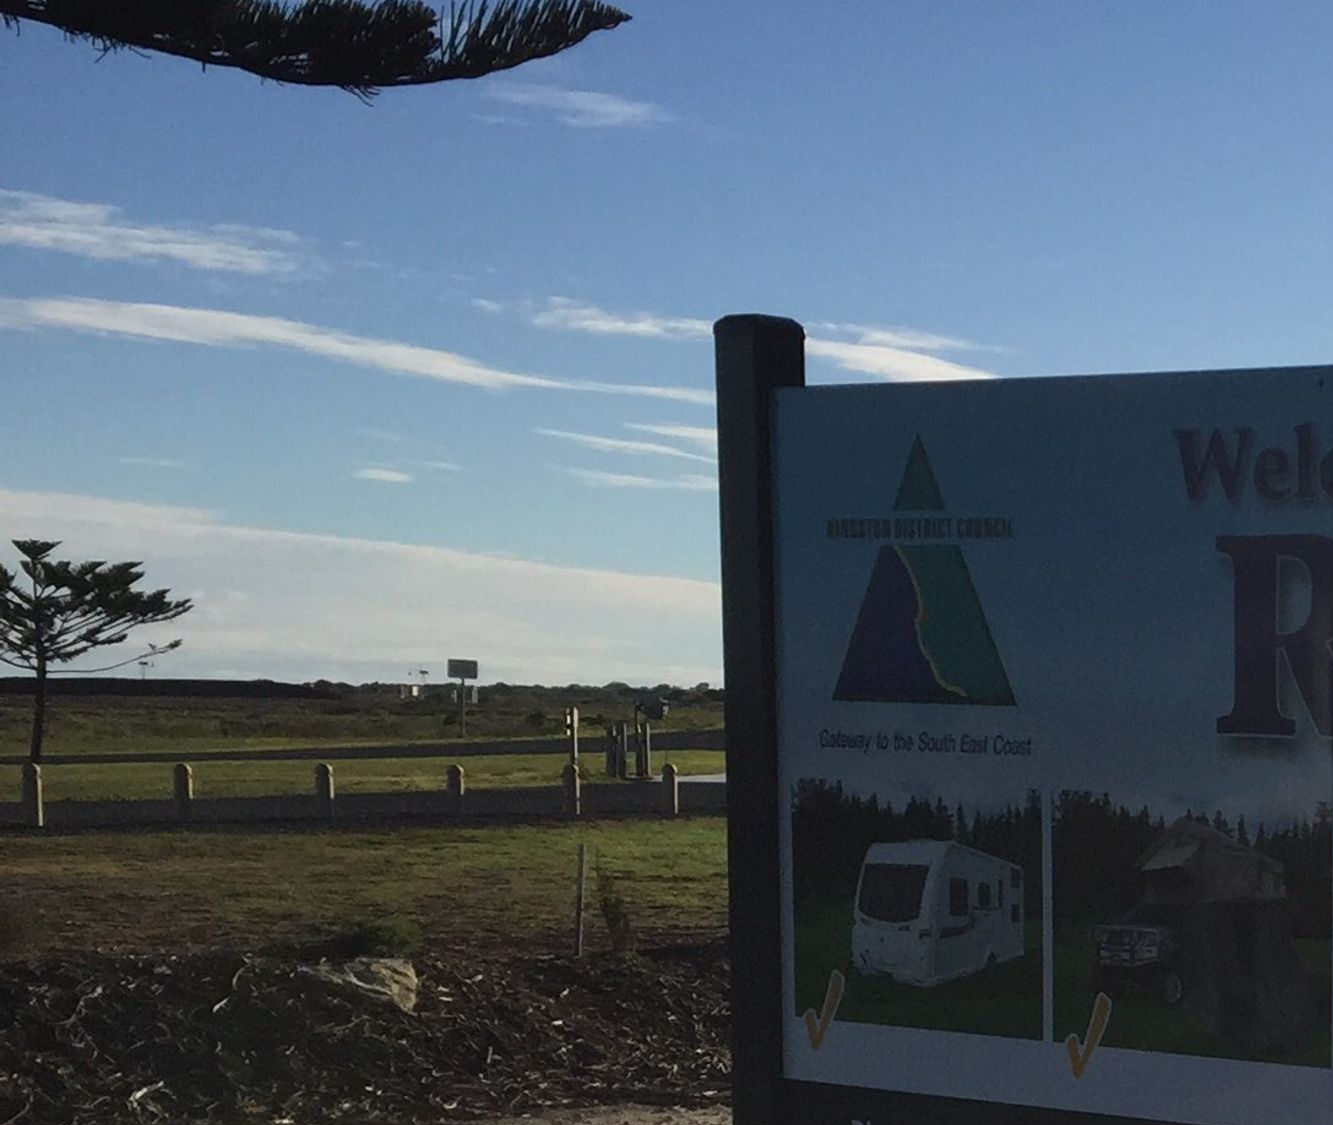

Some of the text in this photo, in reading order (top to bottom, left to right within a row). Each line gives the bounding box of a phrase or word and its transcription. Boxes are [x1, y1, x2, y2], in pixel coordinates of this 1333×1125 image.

[895, 517, 952, 539] DISTRICT
[956, 517, 1015, 539] COUNCIL
[819, 729, 1032, 756] Gateway to the South East Coast
